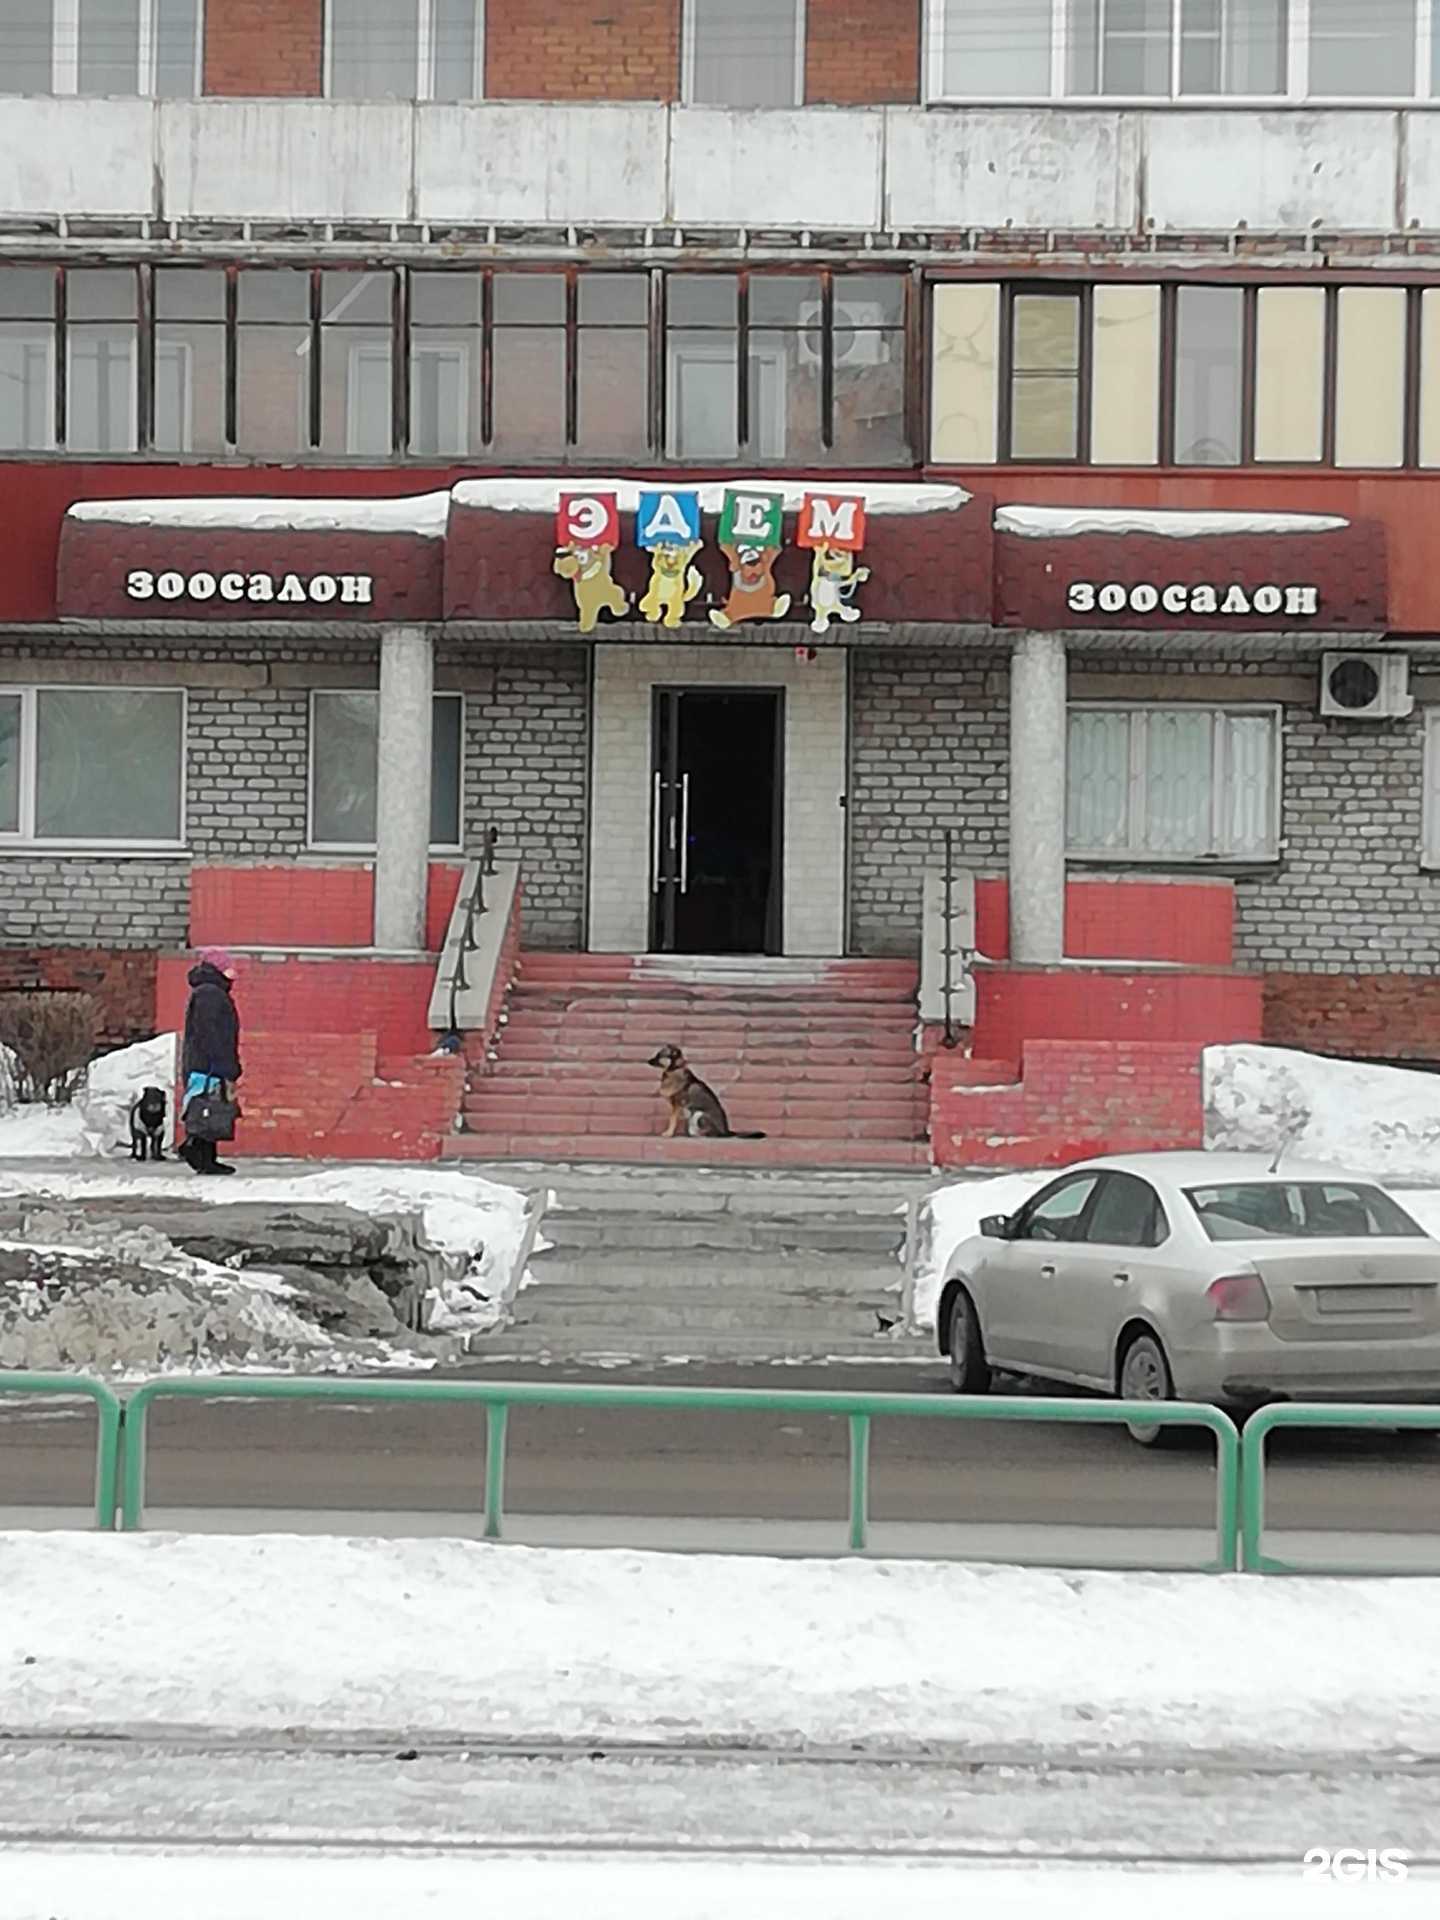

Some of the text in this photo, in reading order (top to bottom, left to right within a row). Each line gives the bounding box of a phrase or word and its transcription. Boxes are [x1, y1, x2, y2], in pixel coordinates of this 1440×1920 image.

[567, 494, 858, 540] ЭДЕМ
[127, 570, 373, 603] зоосалон
[1067, 583, 1318, 614] зоосалон
